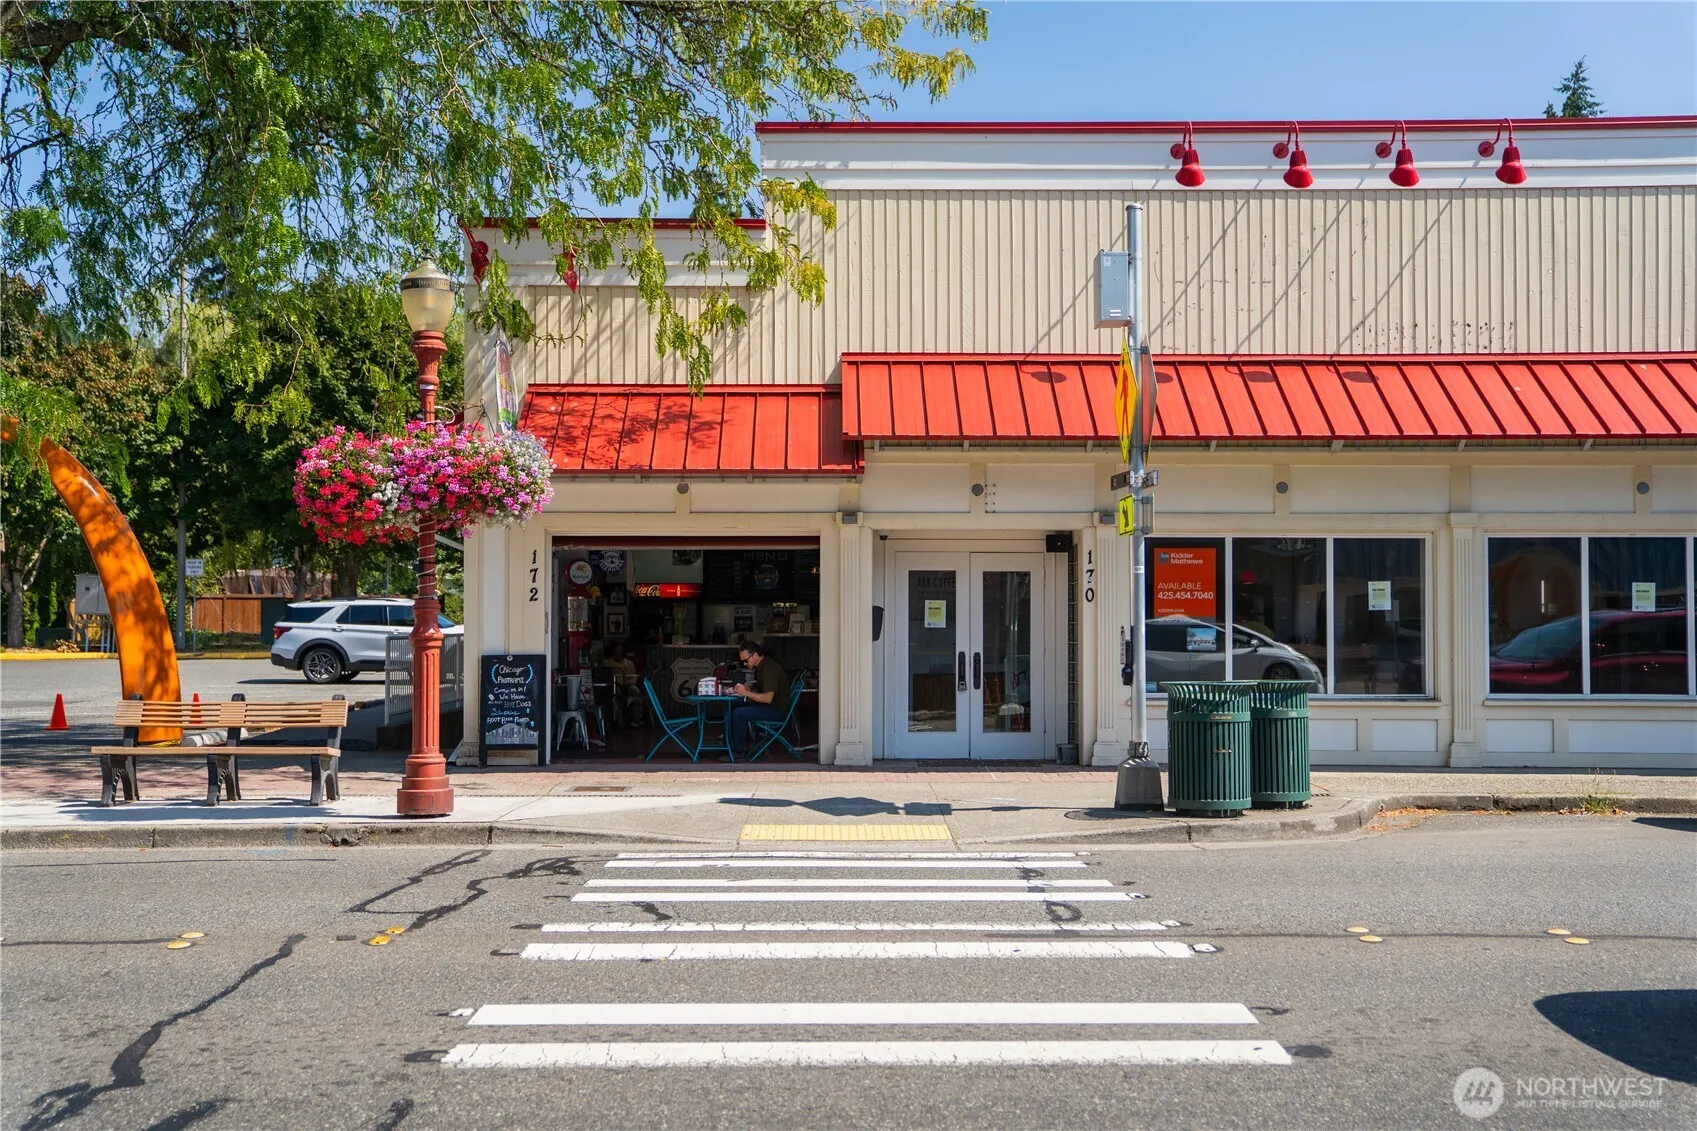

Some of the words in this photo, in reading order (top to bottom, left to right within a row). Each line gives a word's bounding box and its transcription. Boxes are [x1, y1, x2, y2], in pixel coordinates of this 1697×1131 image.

[529, 549, 539, 602] 172
[1084, 550, 1095, 603] 170
[1157, 582, 1202, 590] AVAILABLE
[1157, 591, 1214, 600] 425.454.7040
[498, 664, 527, 676] Chicago
[497, 675, 525, 684] PASTRAMI
[516, 700, 532, 708] DOGS
